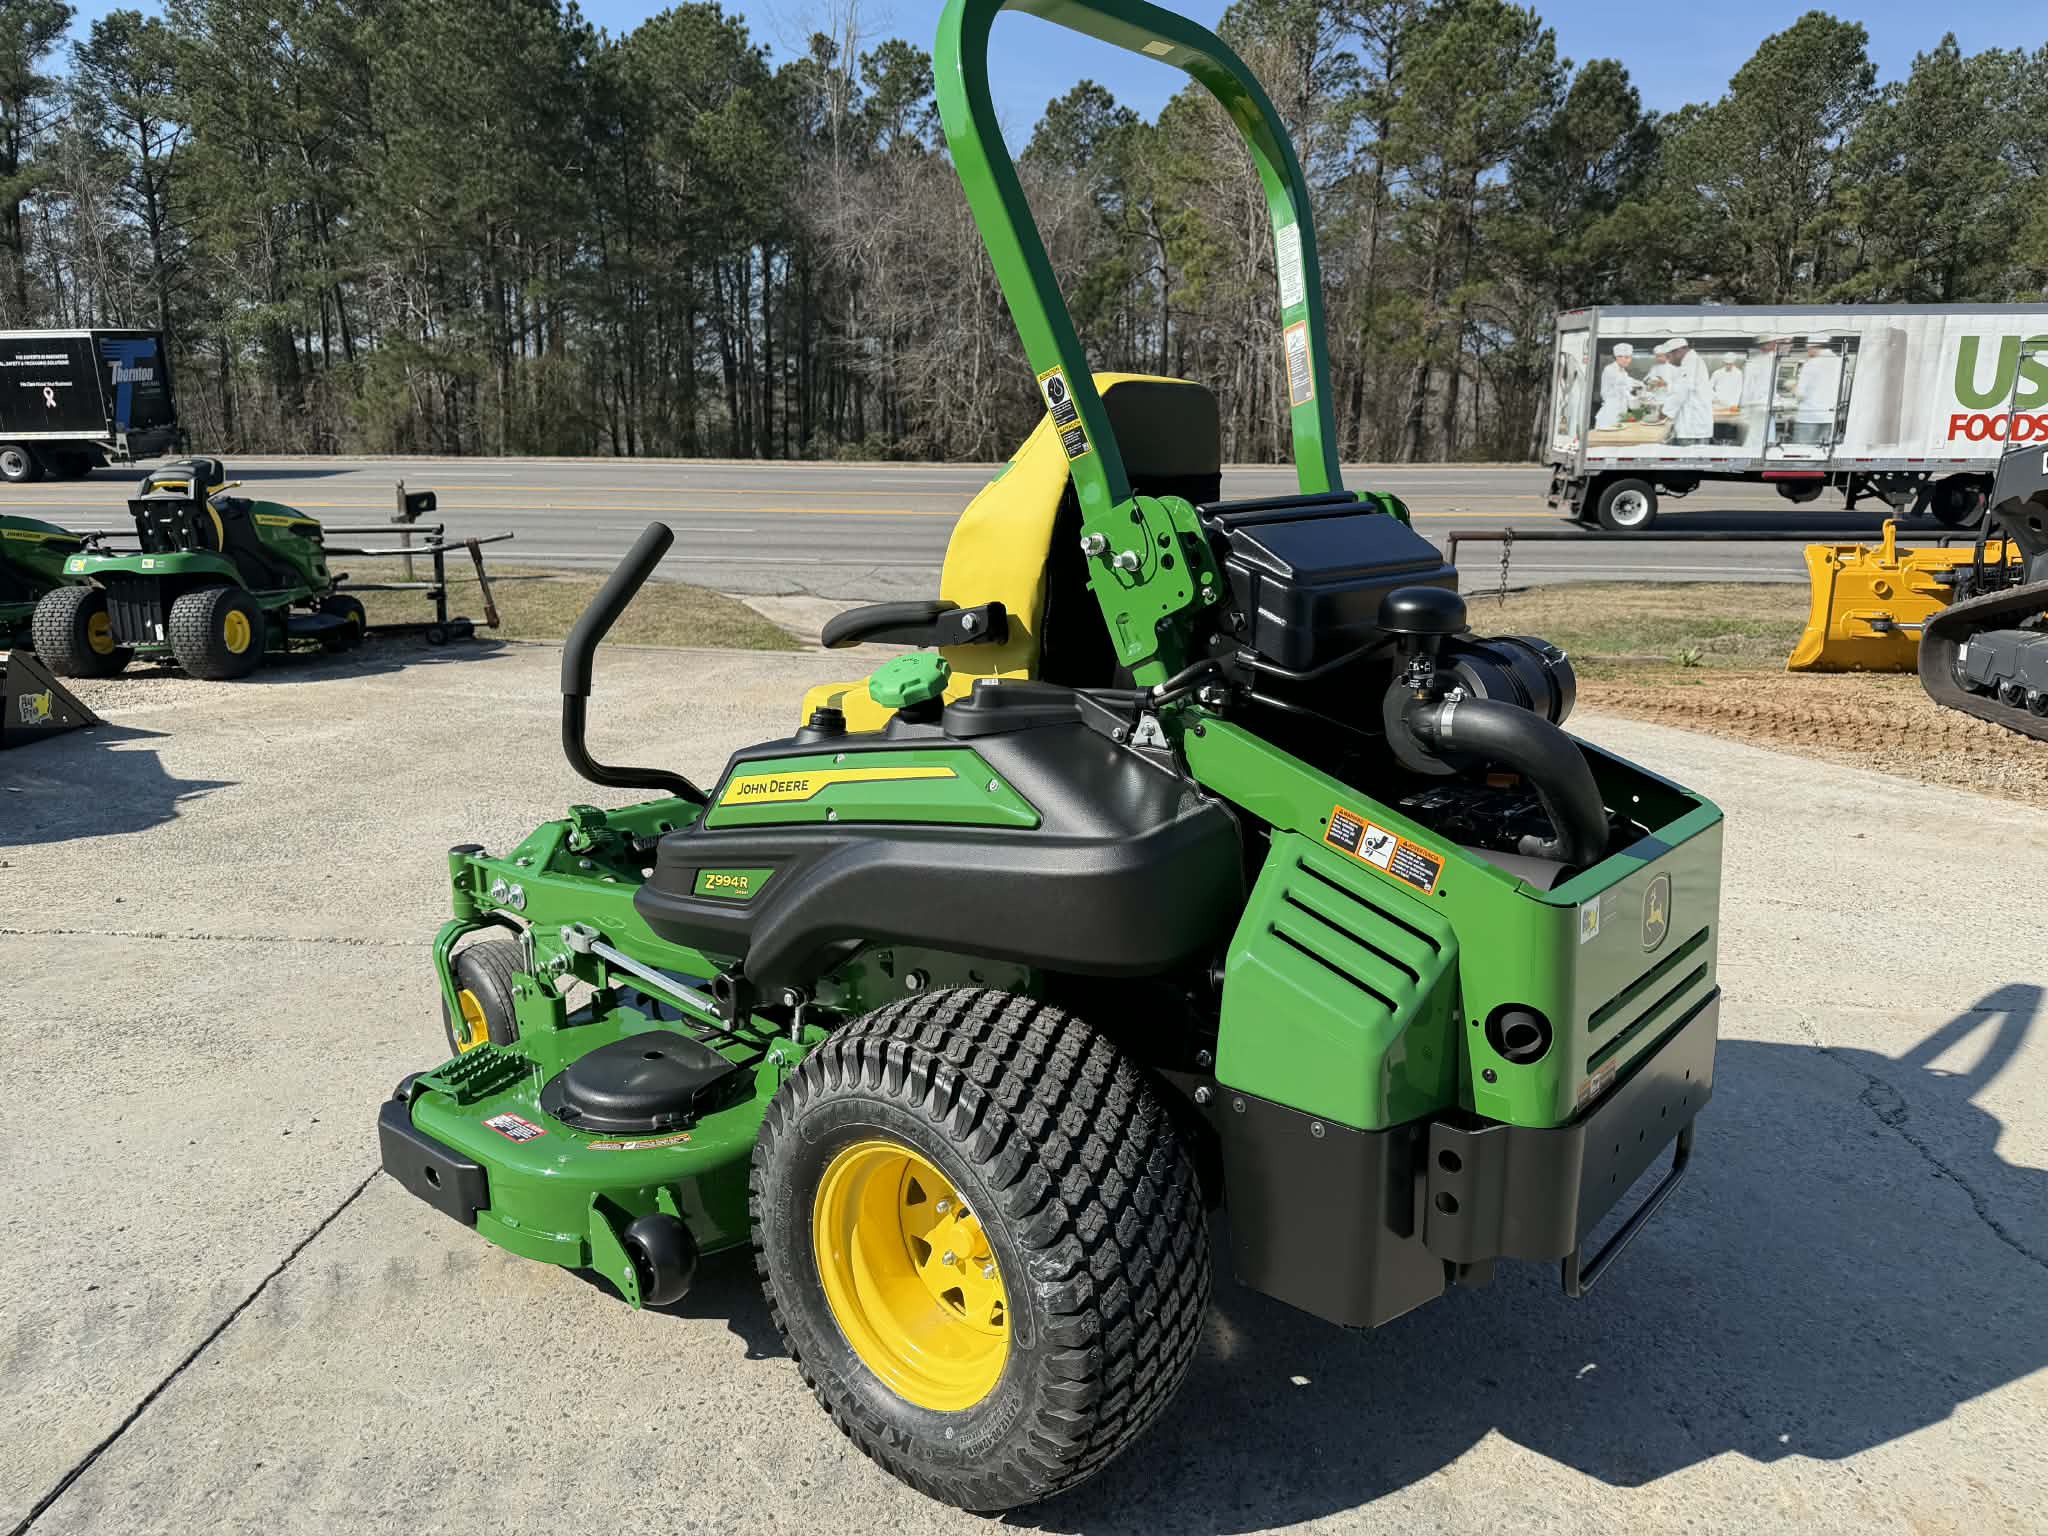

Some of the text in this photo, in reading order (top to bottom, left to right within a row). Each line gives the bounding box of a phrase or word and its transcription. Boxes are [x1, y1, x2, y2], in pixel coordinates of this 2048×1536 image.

[107, 360, 154, 385] Thornton
[1947, 413, 2048, 442] FOODS
[737, 779, 810, 796] JOHN DEERE
[705, 874, 749, 890] Z994R
